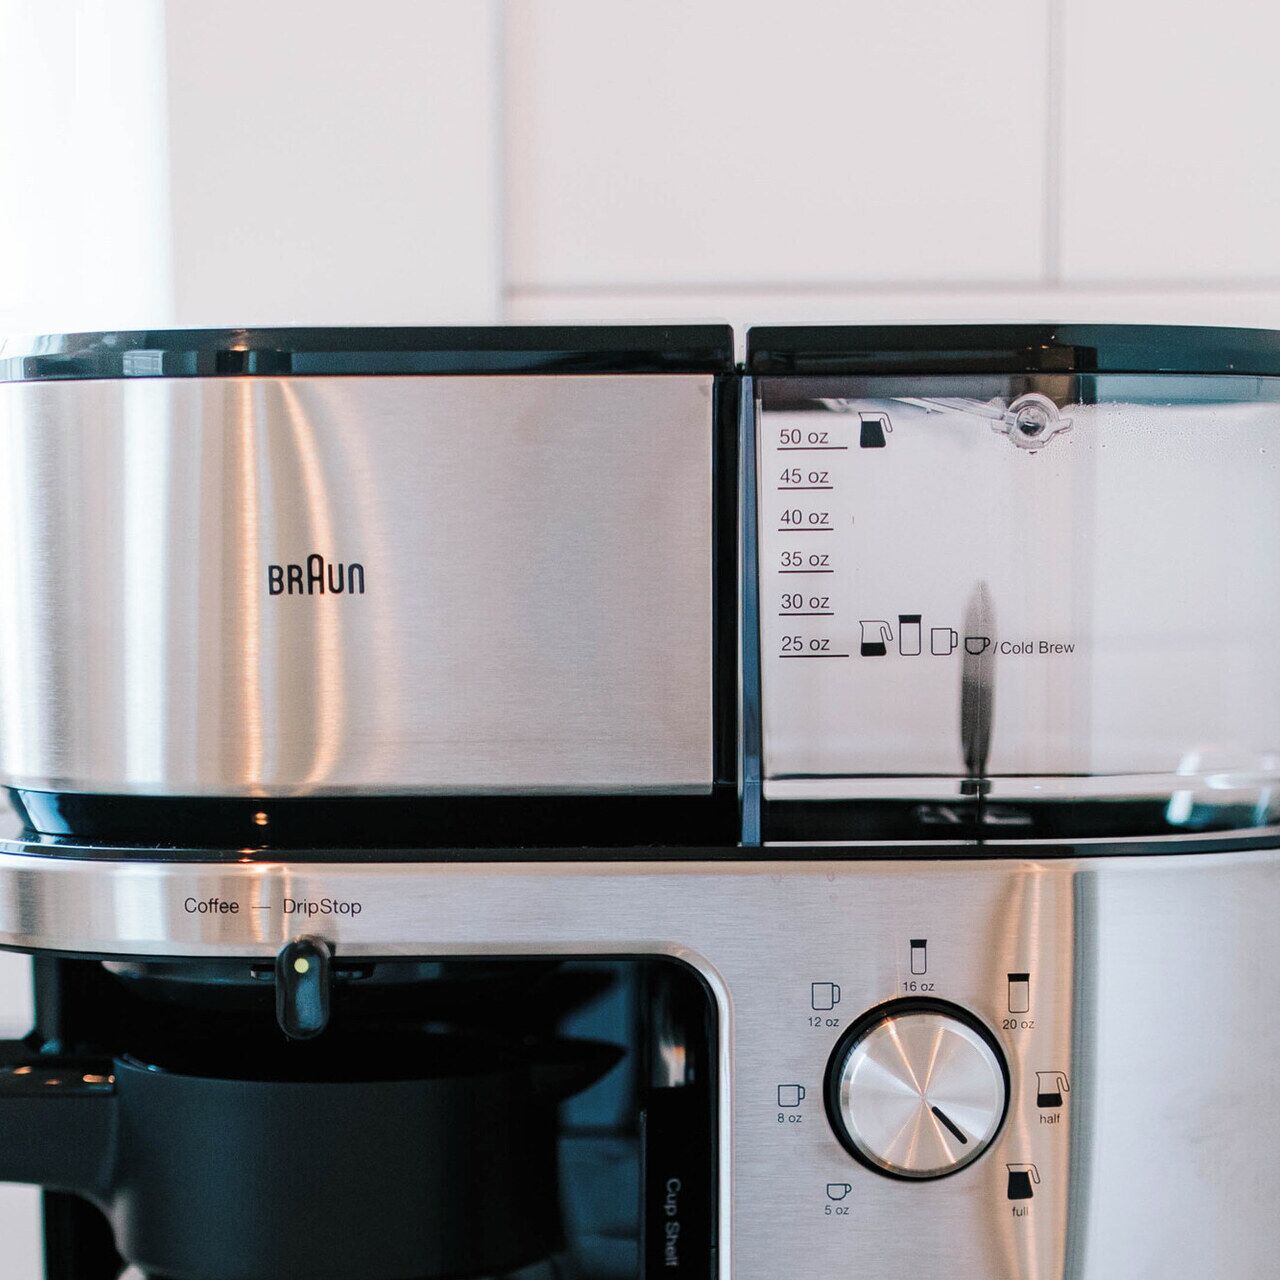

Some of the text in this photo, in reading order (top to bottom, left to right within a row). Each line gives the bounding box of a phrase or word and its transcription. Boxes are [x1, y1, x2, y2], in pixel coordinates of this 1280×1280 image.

[779, 428, 829, 445] 50 oz
[779, 468, 829, 484] 45 oz
[780, 509, 829, 525] 40 oz
[780, 551, 830, 567] 35 oz
[268, 553, 365, 596] BRAUN
[781, 593, 830, 610] 30 oz
[781, 635, 830, 652] 25 oz
[1038, 640, 1075, 654] Brew
[184, 897, 362, 918] Coffee DripStop
[902, 980, 935, 992] 16 oz
[808, 1016, 840, 1028] 12 oz
[1002, 1018, 1036, 1030] 20 oz
[777, 1112, 803, 1124] 8 oz
[1039, 1113, 1061, 1125] half
[824, 1204, 850, 1216] 5 oz
[1011, 1205, 1029, 1218] full
[663, 1178, 682, 1267] Cup Shelf
